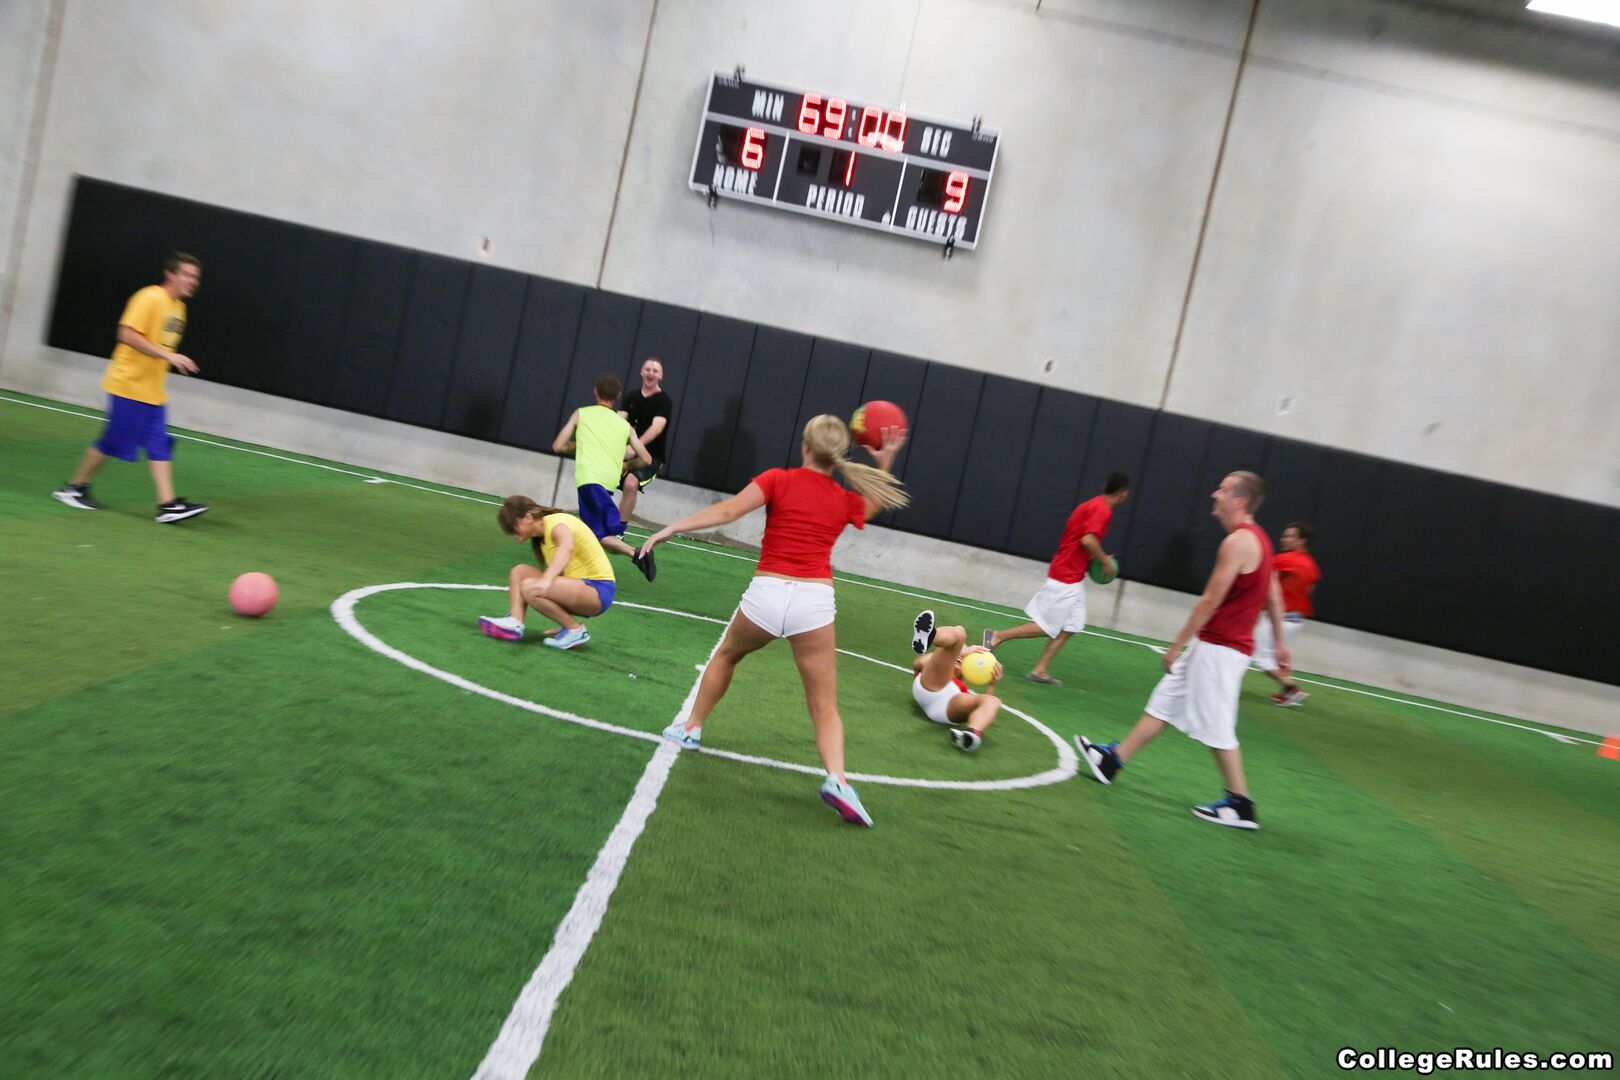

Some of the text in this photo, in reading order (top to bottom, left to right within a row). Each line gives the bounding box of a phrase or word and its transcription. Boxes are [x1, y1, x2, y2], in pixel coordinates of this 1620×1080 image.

[751, 89, 784, 122] MIN
[741, 127, 766, 170] 6
[712, 163, 758, 196] HOME
[846, 150, 856, 187] 1
[805, 183, 866, 218] PERIOD
[943, 171, 970, 213] 9
[905, 205, 968, 241] GUESTS
